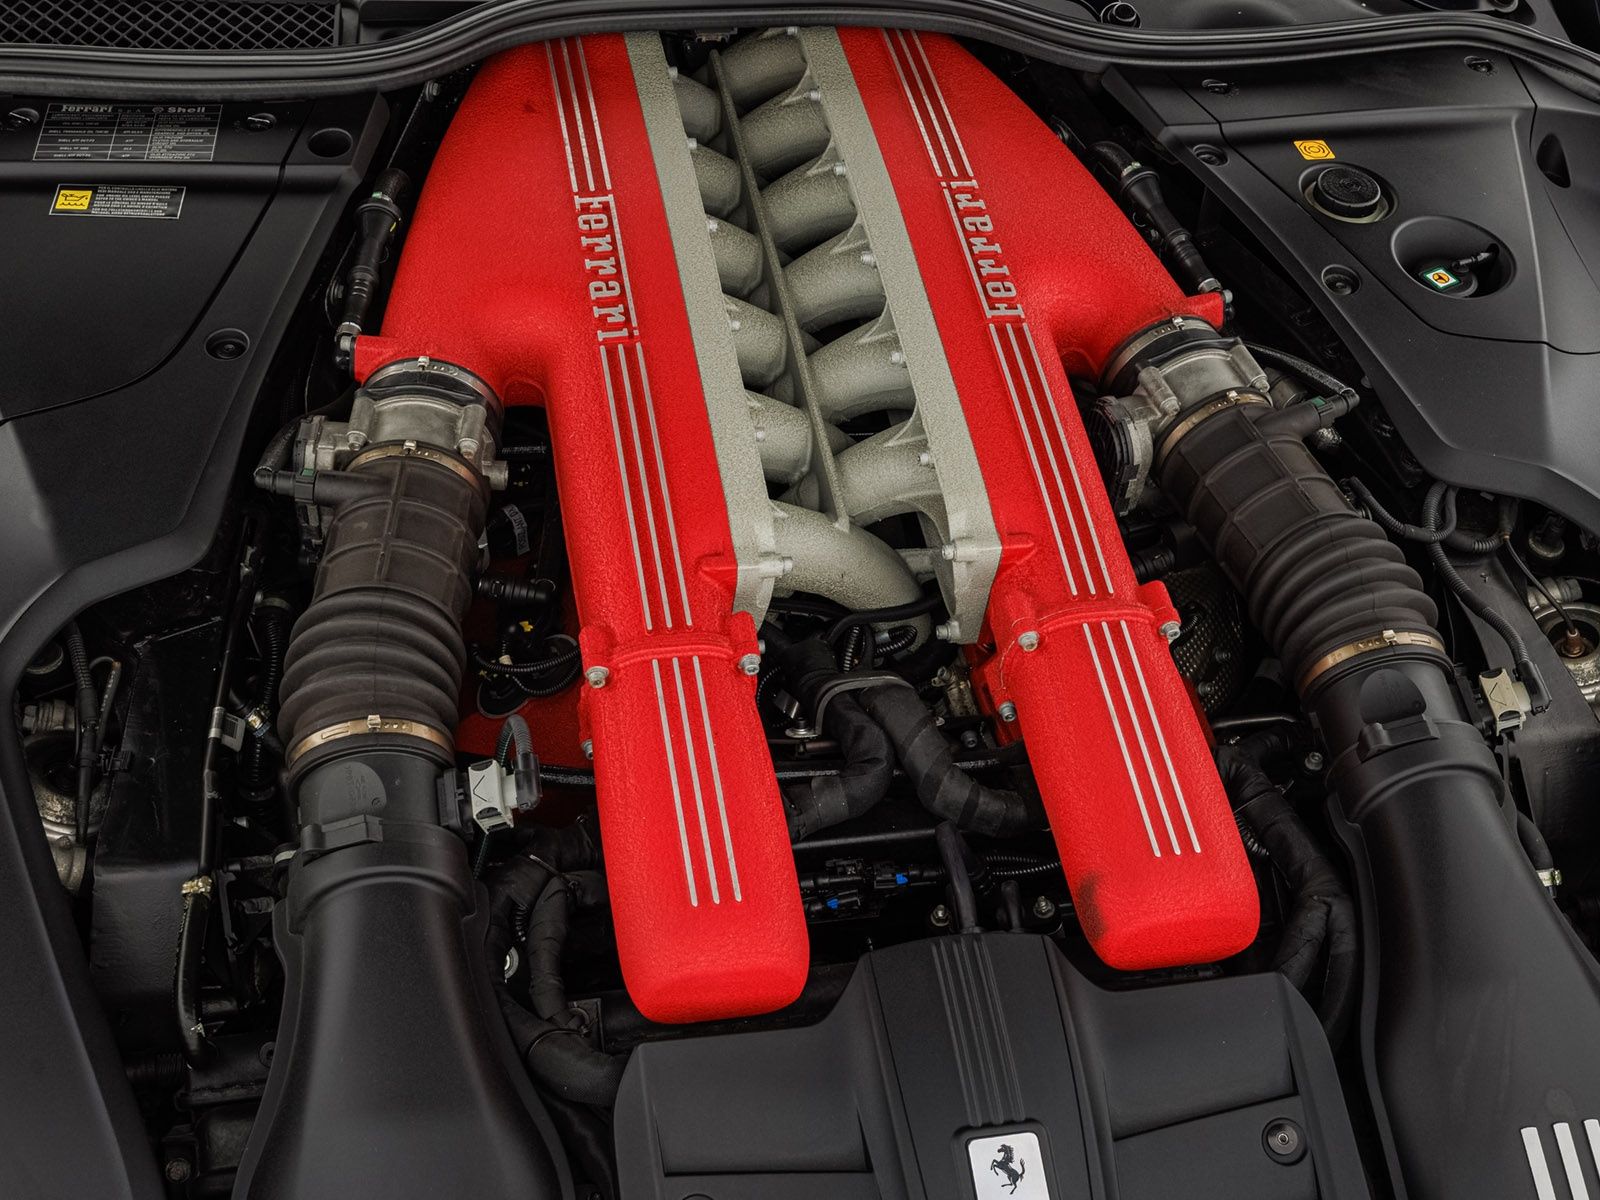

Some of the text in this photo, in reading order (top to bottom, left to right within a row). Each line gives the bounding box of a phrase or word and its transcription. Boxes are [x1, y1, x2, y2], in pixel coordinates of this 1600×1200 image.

[61, 104, 113, 112] Ferrari
[573, 194, 639, 342] Ferrari
[940, 179, 1026, 319] Ferrari
